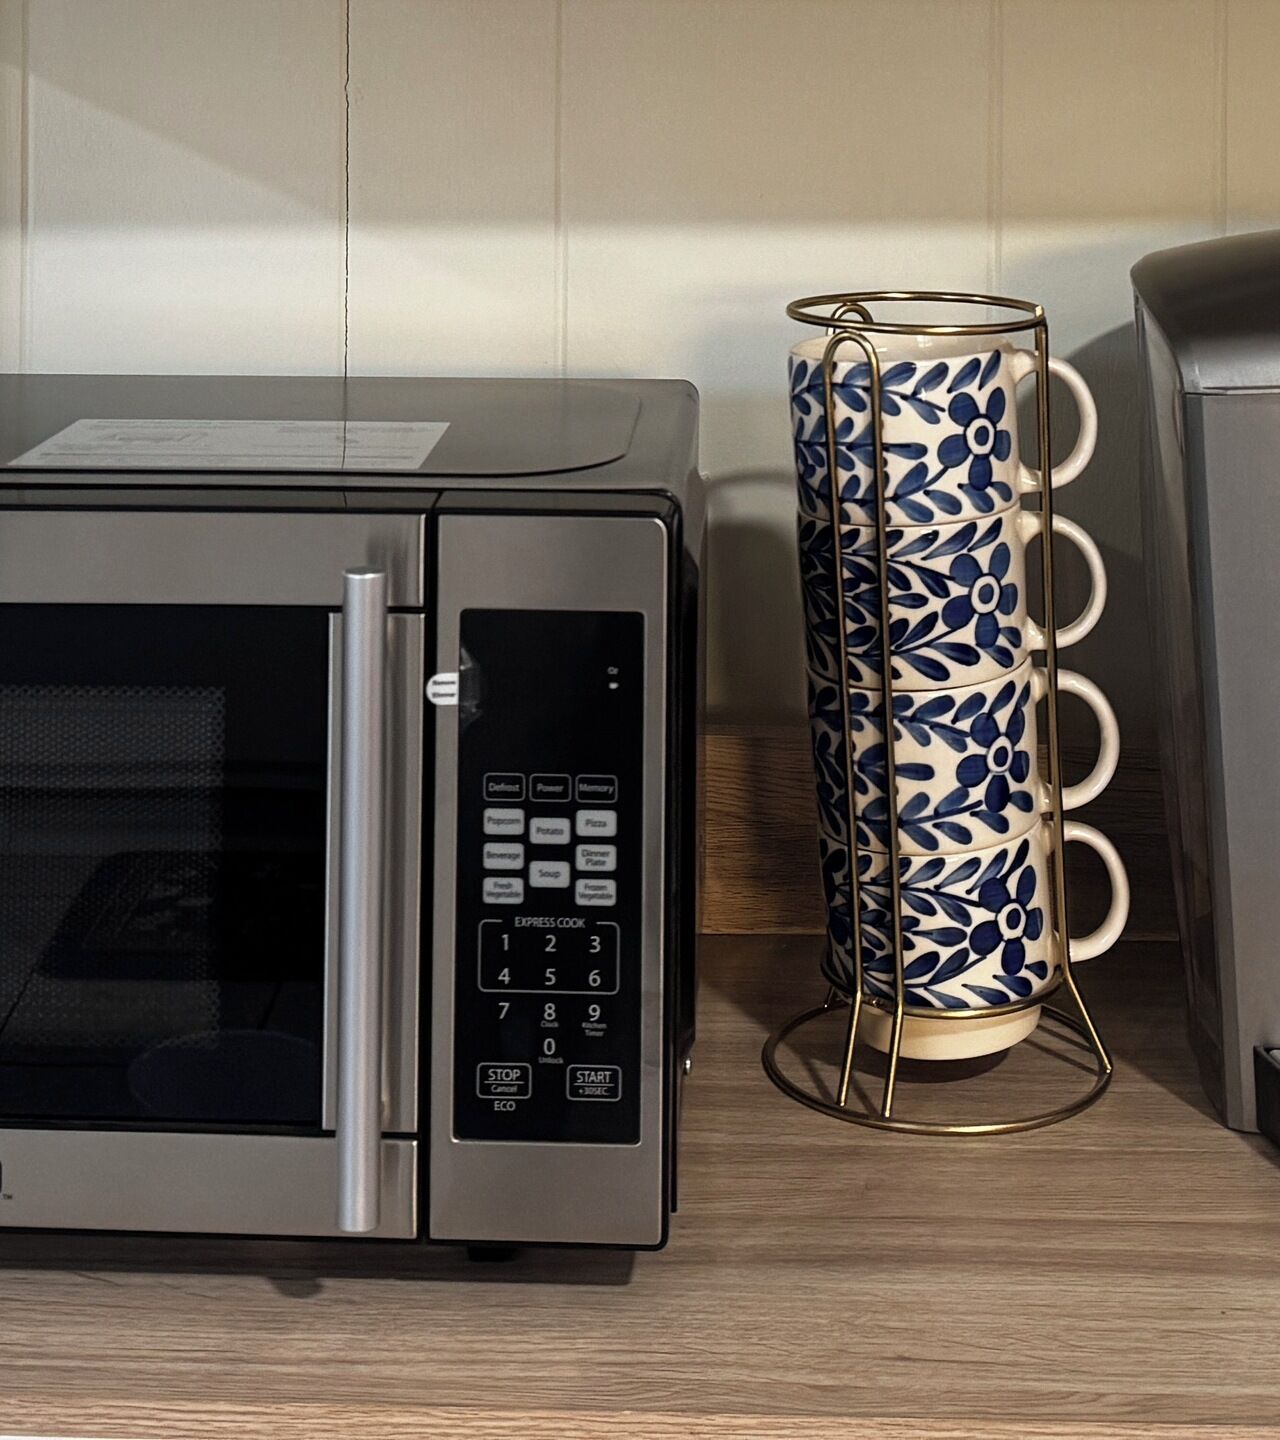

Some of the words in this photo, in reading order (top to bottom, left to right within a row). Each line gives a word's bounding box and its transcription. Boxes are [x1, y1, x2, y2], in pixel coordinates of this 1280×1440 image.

[488, 782, 520, 792] Defrost
[536, 783, 564, 793] Power
[579, 783, 614, 795] Memory
[487, 816, 521, 826] Popcorn
[585, 818, 607, 828] Pizza
[536, 826, 564, 835] Potato
[486, 851, 521, 861] Beverage
[581, 849, 610, 857] Dinner
[585, 858, 607, 866] Plate
[538, 869, 561, 879] Soup
[493, 881, 513, 889] Fresh
[584, 883, 608, 891] Frozen
[578, 892, 613, 901] Vegetable
[514, 916, 556, 928] EXPRESS
[557, 917, 586, 929] COOK
[501, 934, 509, 951] 1
[544, 934, 557, 952] 2
[588, 935, 601, 953] 3
[497, 967, 511, 985] 4
[544, 968, 556, 986] 5
[588, 969, 601, 987] 6
[498, 1002, 510, 1019] 7
[544, 1003, 556, 1020] 8
[588, 1004, 601, 1021] 9
[543, 1038, 556, 1055] 0
[488, 1068, 521, 1081] STOP
[576, 1070, 612, 1083] START
[490, 1084, 518, 1093] Cancel
[493, 1100, 516, 1111] ECO
